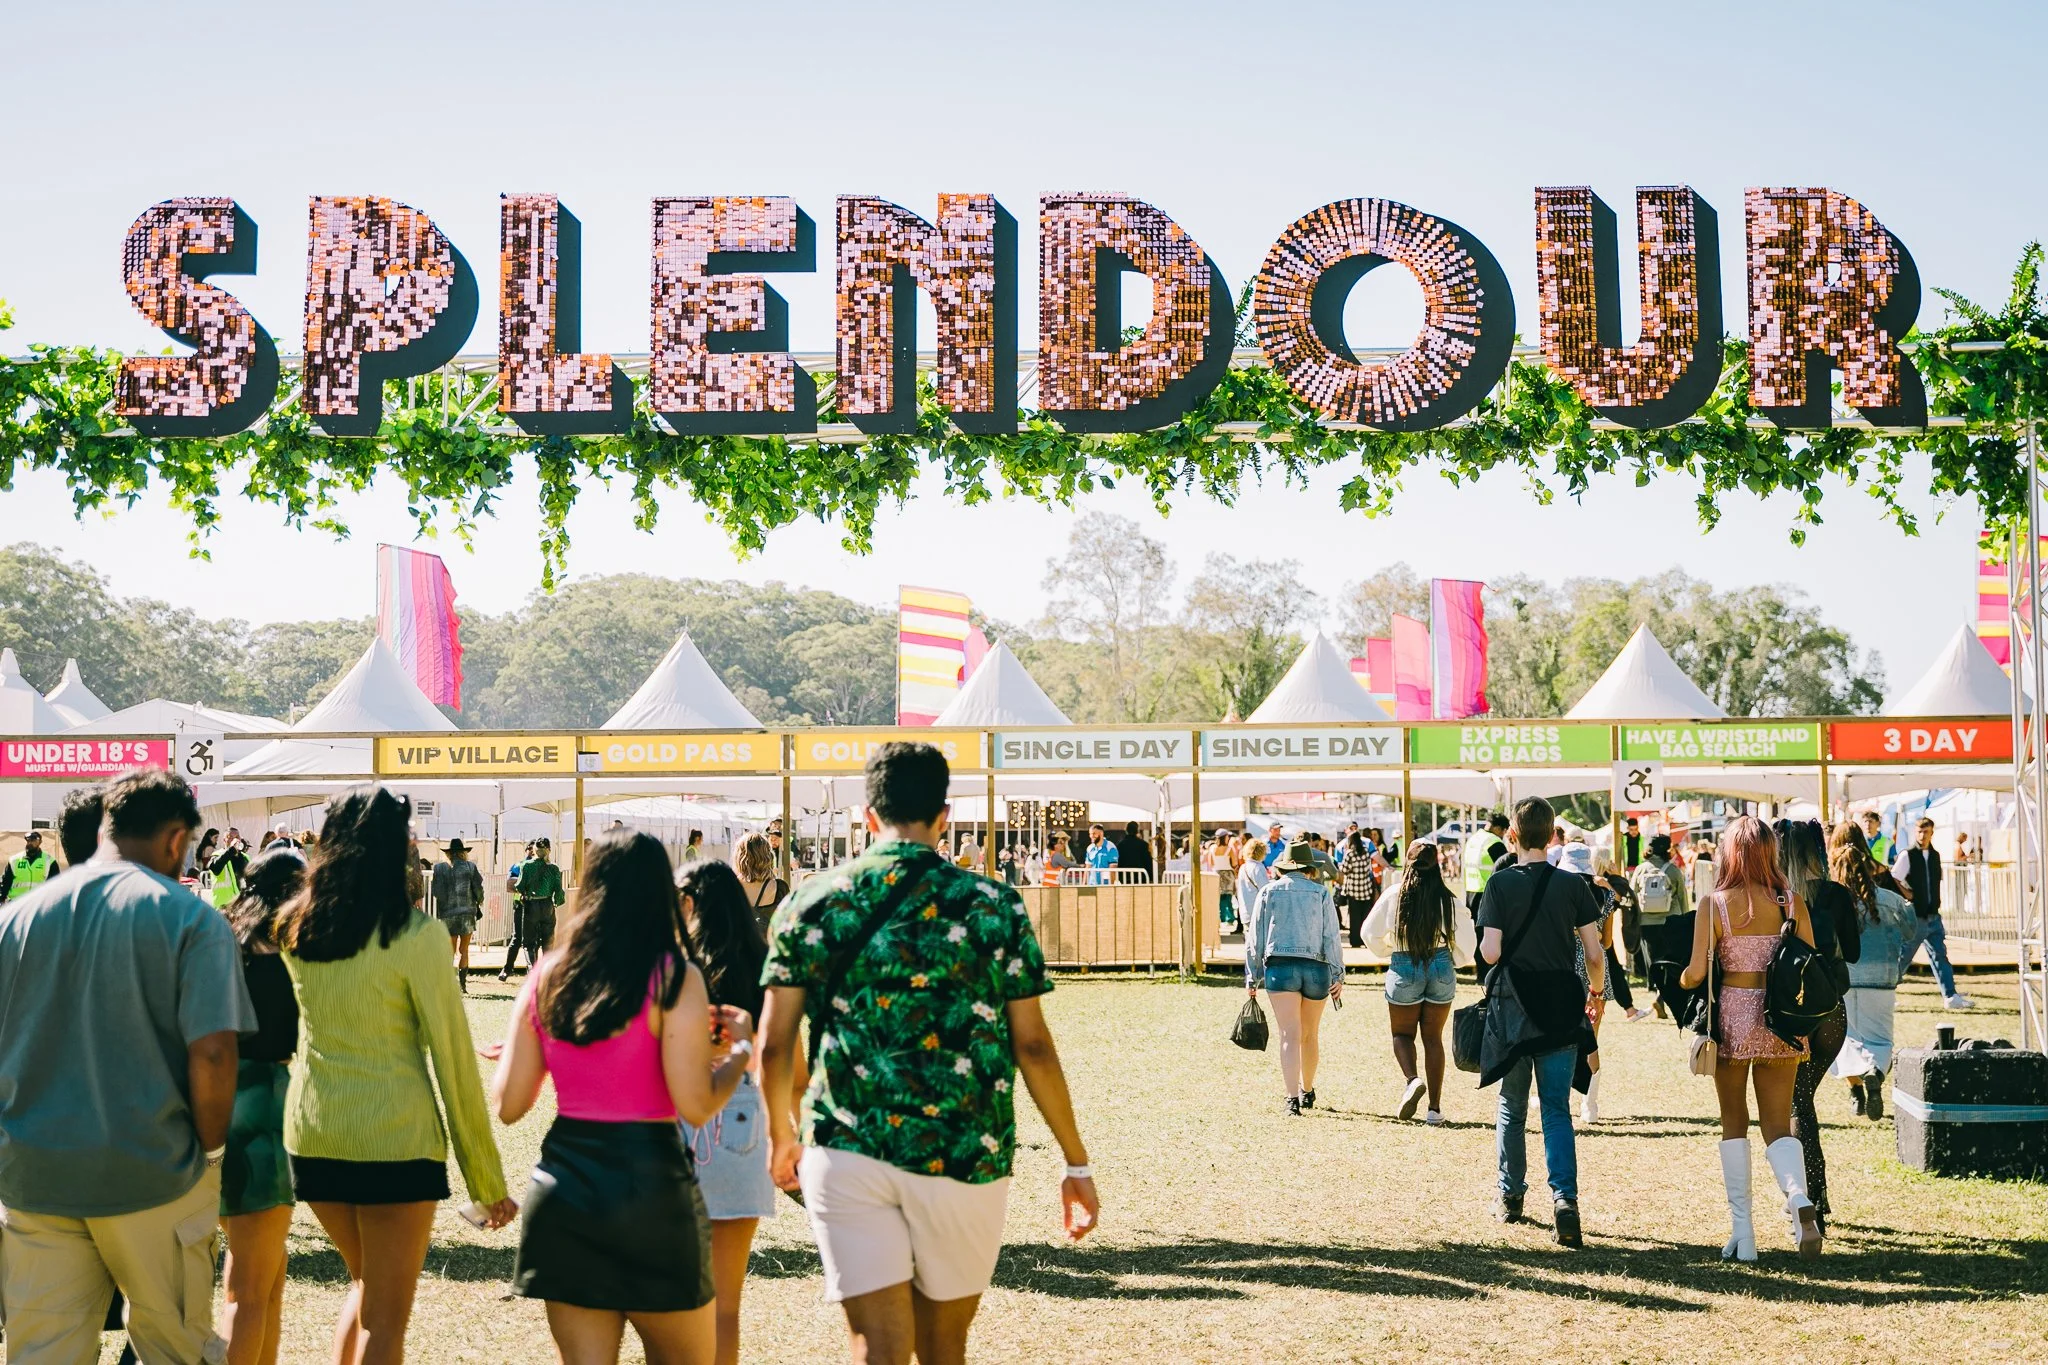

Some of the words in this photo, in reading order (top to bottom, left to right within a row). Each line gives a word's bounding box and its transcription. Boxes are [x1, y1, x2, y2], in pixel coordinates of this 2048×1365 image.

[116, 186, 1927, 435] SPLENDOUR
[1461, 727, 1560, 744] EXPRESS
[1627, 730, 1676, 744] HAVE
[1680, 729, 1694, 743] A
[1698, 728, 1809, 743] WRISTBAND
[1884, 729, 1901, 752] 3
[1910, 729, 1978, 752] DAY
[8, 743, 92, 763] UNDER
[98, 742, 149, 762] 18'S
[399, 747, 441, 764] VIP
[448, 746, 559, 764] VILLAGE
[607, 743, 678, 763] GOLD
[685, 743, 752, 763] PASS
[1004, 740, 1110, 760] SINGLE
[1120, 739, 1180, 759] DAY
[1212, 738, 1319, 758] SINGLE
[1329, 737, 1390, 757] DAY
[1459, 746, 1493, 763] NO
[1499, 745, 1562, 762] BAGS
[1660, 743, 1698, 757] BAG
[1702, 743, 1776, 757] SEARCH
[25, 764, 52, 773] MUST
[54, 764, 66, 773] BE
